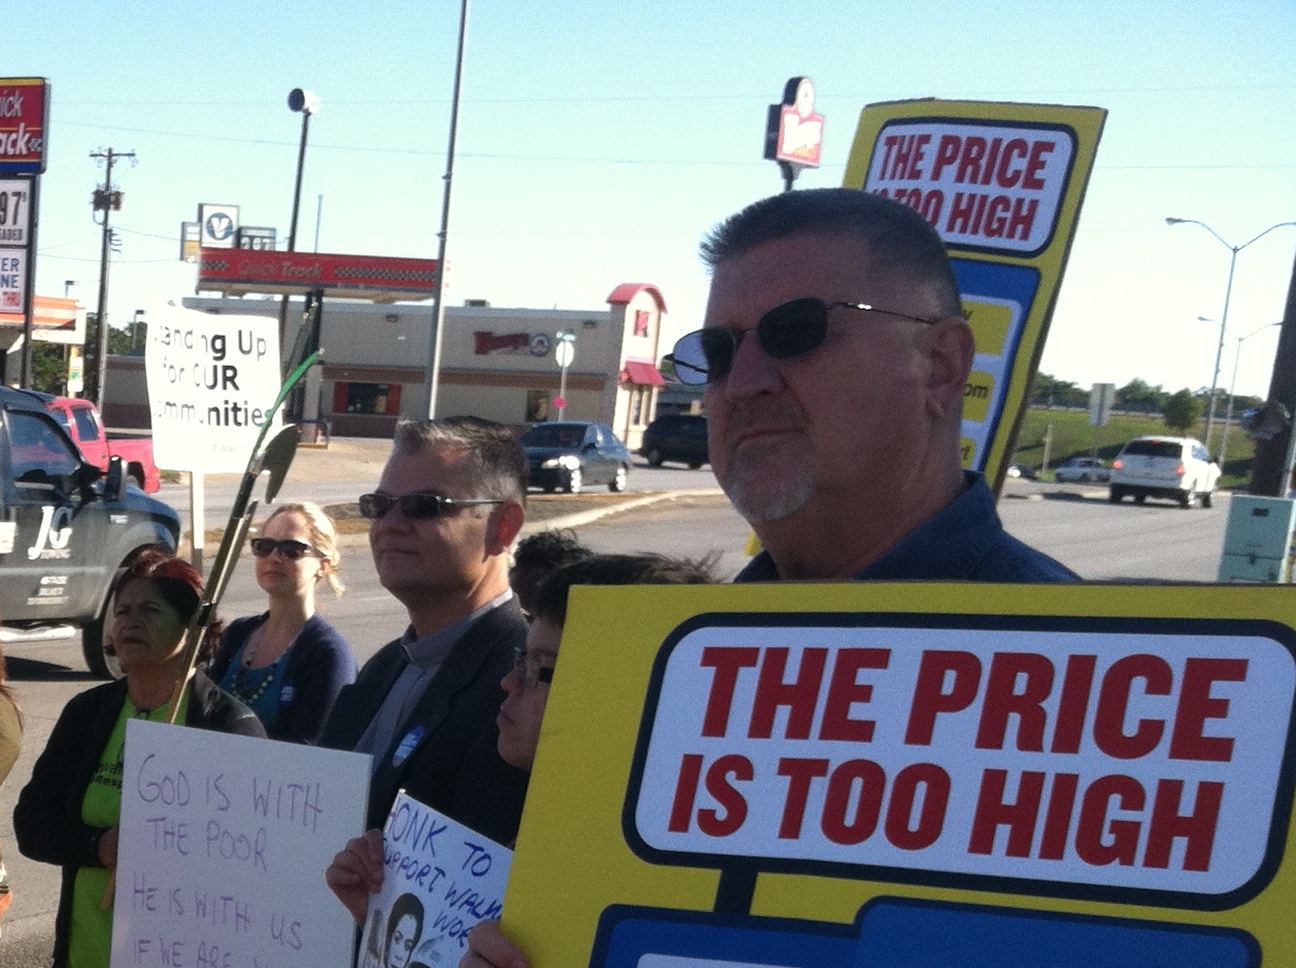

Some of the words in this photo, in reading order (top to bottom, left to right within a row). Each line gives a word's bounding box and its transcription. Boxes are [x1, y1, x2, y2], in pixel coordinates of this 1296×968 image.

[878, 134, 932, 181] THE
[929, 135, 1056, 190] PRICE
[945, 192, 1040, 241] HIGH
[237, 329, 267, 362] Up
[192, 362, 241, 392] OUR
[700, 645, 893, 744] THE
[904, 649, 1250, 763] PRICE
[205, 773, 231, 812] IS
[252, 777, 324, 834] WITH
[667, 753, 755, 838] IS
[777, 757, 952, 851] TOO
[967, 768, 1225, 873] HIGH
[147, 816, 189, 857] THE
[206, 819, 268, 872] POOR
[462, 841, 492, 878] TO
[132, 872, 159, 912] HE
[168, 887, 185, 918] IS
[194, 890, 251, 934] WITH
[270, 916, 303, 951] US
[133, 939, 151, 965] IF
[159, 941, 184, 968] WE
